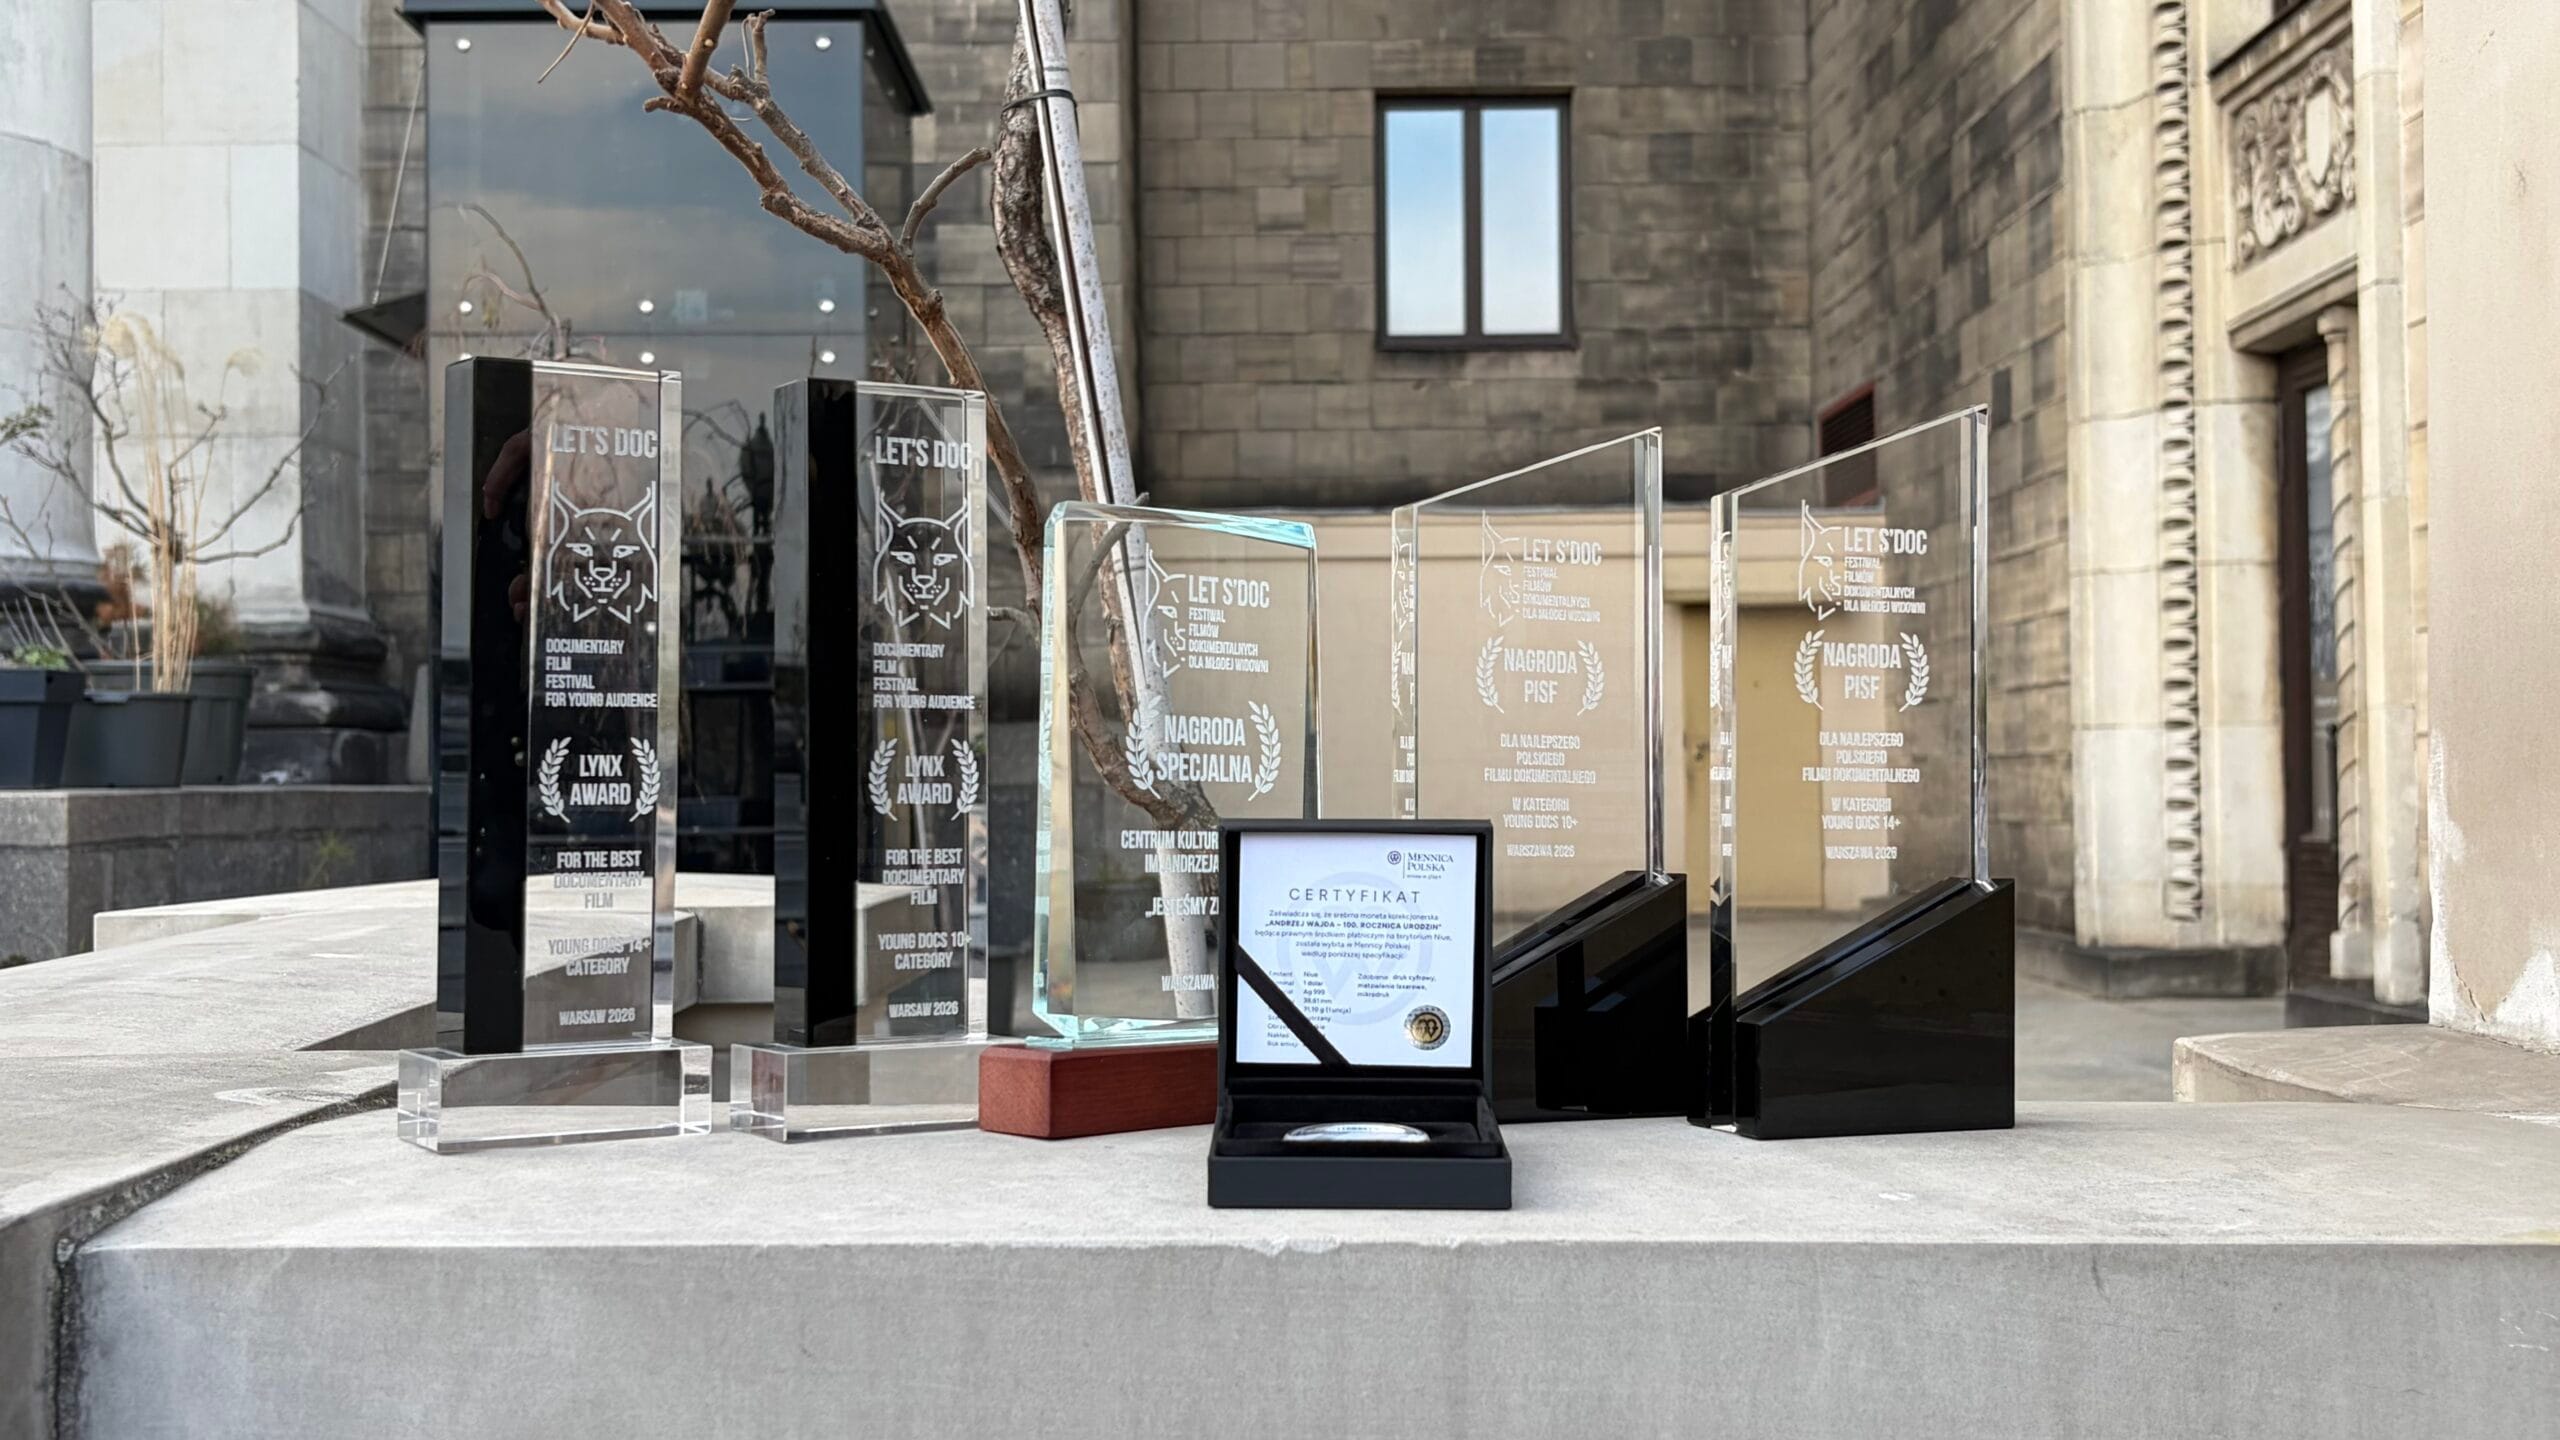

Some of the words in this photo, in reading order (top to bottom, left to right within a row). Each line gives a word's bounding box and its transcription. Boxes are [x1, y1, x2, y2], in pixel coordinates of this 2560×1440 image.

[552, 424, 609, 455] LET'S
[615, 427, 658, 458] DOC
[875, 436, 929, 467] LET'S
[933, 440, 972, 470] DOC
[1844, 526, 1875, 552] LET
[1524, 537, 1552, 562] LET
[1844, 556, 1882, 569] FESTIWAL
[1189, 575, 1218, 604] LET
[1222, 577, 1270, 608] S'DOC
[1844, 585, 1916, 599] DOKUMENTALNYCH
[1844, 600, 1859, 612] DLA
[1891, 601, 1926, 614] WIDOWNI
[1189, 608, 1226, 623] FESTIWAL
[1189, 622, 1220, 638] FILMÓW
[545, 638, 625, 654] DOCUMENTARY
[873, 642, 945, 658] DOCUMENTARY
[1189, 639, 1258, 656] DOKUMENTALNYCH
[545, 656, 571, 671] FILM
[1504, 648, 1578, 674] NAGRODA
[1824, 642, 1902, 669] NAGRODA
[873, 660, 897, 674] FILM
[1189, 655, 1204, 669] DLA
[1205, 656, 1234, 671] MŁODEJ
[1235, 658, 1269, 673] WIDOWNI
[545, 674, 595, 689] FESTIVAL
[873, 677, 919, 691] FESTIVAL
[1844, 675, 1880, 700] PISF
[1524, 679, 1559, 704] PISF
[545, 692, 567, 707] FOR
[568, 692, 603, 707] YOUNG
[606, 693, 658, 708] AUDIENCE
[873, 694, 892, 708] FOR
[894, 694, 926, 709] YOUNG
[928, 695, 975, 710] AUDIENCE
[1164, 714, 1246, 747] NAGRODA
[1500, 734, 1518, 748] DLA
[1520, 734, 1580, 750] NAJLEPSZEGO
[1820, 731, 1838, 746] DLA
[1840, 732, 1904, 747] NAJLEPSZEGO
[1516, 751, 1565, 766] POLSKIEGO
[1836, 750, 1888, 764] POLSKIEGO
[579, 755, 623, 777] LYNX
[905, 756, 945, 777] LYNX
[1156, 752, 1252, 783] SPECJALNA
[1484, 768, 1512, 782] FILMU
[1514, 768, 1596, 784] DOKUMENTALNEGO
[1802, 767, 1832, 782] FILMU
[1833, 768, 1920, 783] DOKUMENTALNEGO
[570, 783, 631, 806] AWARD
[897, 783, 952, 804] AWARD
[1512, 797, 1521, 811] W
[1523, 797, 1570, 812] KATEGORII
[1832, 797, 1841, 812] W
[1842, 797, 1892, 812] KATEGORII
[1503, 814, 1534, 828] YOUNG
[1535, 815, 1559, 828] DOCS
[1822, 814, 1854, 830] YOUNG
[1855, 815, 1880, 830] DOCS
[1883, 815, 1901, 830] 14+
[1121, 830, 1175, 849] CENTRUM
[1178, 831, 1219, 850] KULTUR
[886, 850, 908, 866] FOR
[910, 849, 932, 865] THE
[934, 848, 963, 864] BEST
[1408, 852, 1454, 863] MENNICA
[1506, 844, 1552, 857] WARSZAWA
[1825, 846, 1874, 860] WARSZAWA
[1875, 846, 1898, 860] 2026
[557, 852, 581, 869] FOR
[584, 851, 608, 868] THE
[610, 850, 642, 867] BEST
[1165, 854, 1219, 872] ANDRZEJA
[1408, 862, 1446, 872] POLSKA
[554, 871, 645, 888] DOCUMENTARY
[883, 868, 966, 885] DOCUMENTARY
[584, 893, 614, 908] FILM
[910, 889, 938, 905] FILM
[1289, 888, 1422, 904] CERTYFIKAT
[1209, 896, 1219, 915] Z
[1306, 920, 1335, 928] WAJDA
[1360, 922, 1401, 930] ROCZNICA
[548, 938, 592, 954] YOUNG
[593, 936, 625, 953] DOCS
[628, 936, 651, 952] 14+
[878, 932, 916, 950] YOUNG
[918, 932, 948, 949] DOCS
[951, 932, 972, 948] 10+
[566, 957, 630, 976] CATEGORY
[894, 952, 953, 970] CATEGORY
[1162, 974, 1216, 992] WARSZAWA
[559, 1009, 606, 1025] WARSAW
[608, 1008, 635, 1023] 2026
[888, 1003, 932, 1018] WARSAW
[933, 1002, 958, 1016] 2026
